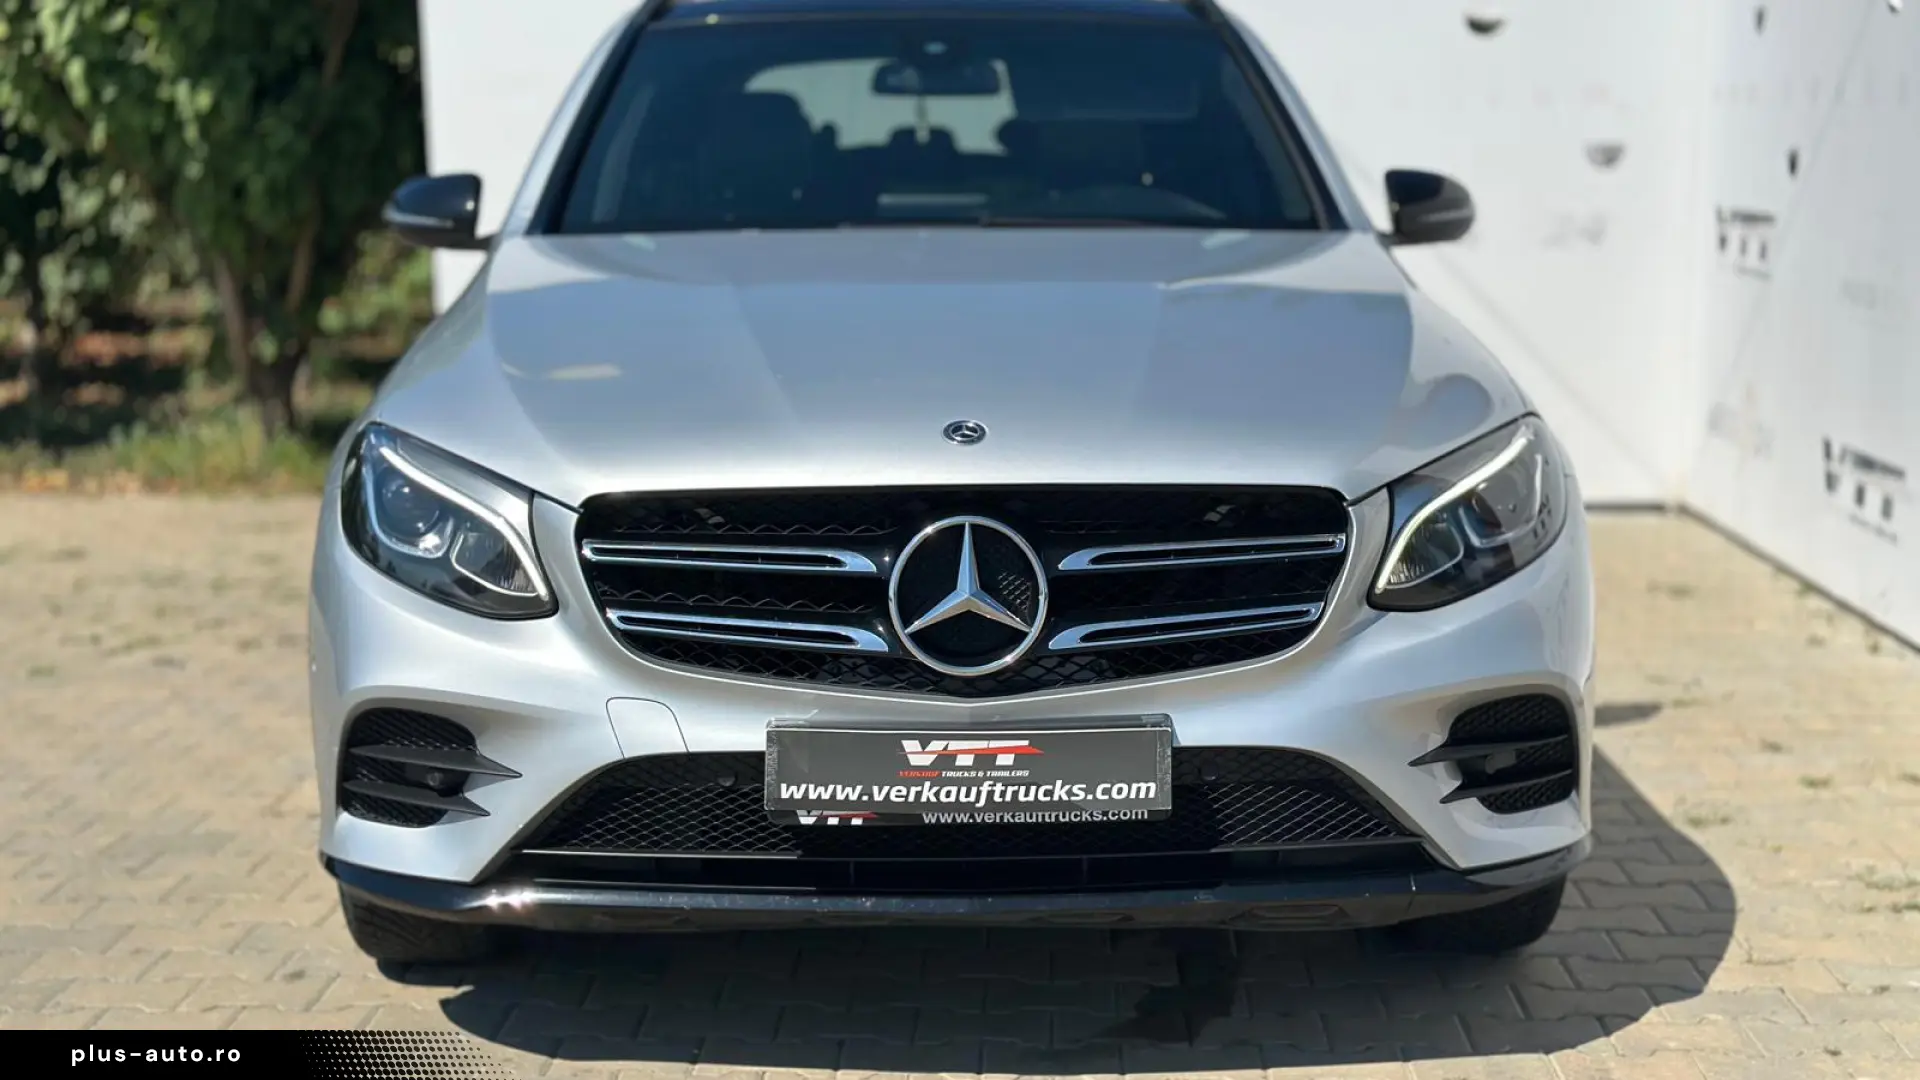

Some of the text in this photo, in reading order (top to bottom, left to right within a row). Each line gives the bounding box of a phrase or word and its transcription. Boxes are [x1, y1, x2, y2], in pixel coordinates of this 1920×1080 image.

[900, 739, 1030, 767] VTT
[941, 770, 976, 778] TRUCKS
[986, 769, 1030, 777] TRAILERS
[780, 779, 1157, 808] www.verkauftrucks.com
[921, 808, 1149, 824] www.verkauftrucks.com
